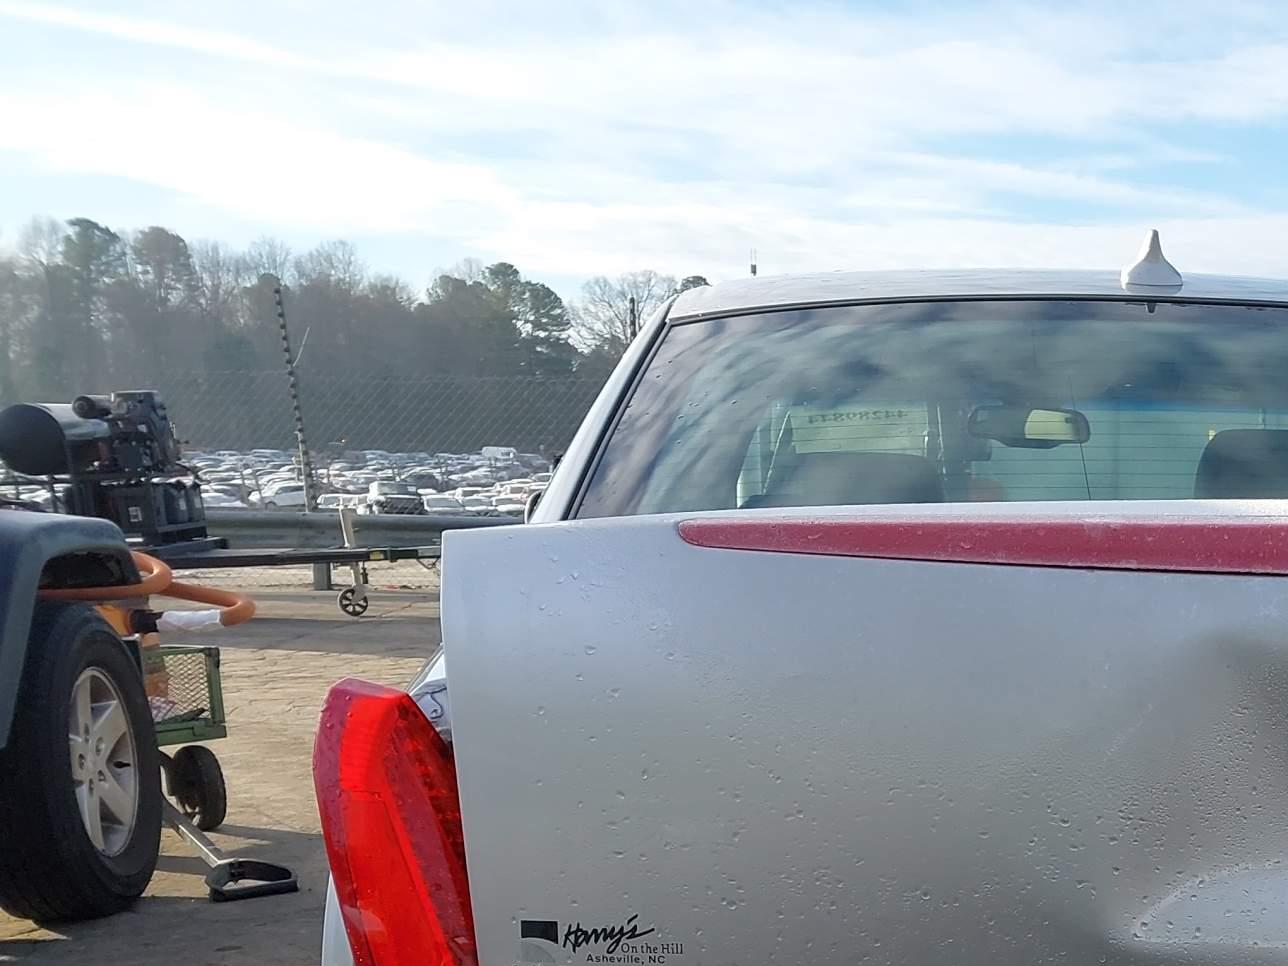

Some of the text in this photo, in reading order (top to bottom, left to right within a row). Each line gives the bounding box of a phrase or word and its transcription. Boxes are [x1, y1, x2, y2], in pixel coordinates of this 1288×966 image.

[562, 913, 655, 955] Harry's
[620, 942, 684, 955] On the Hill
[586, 953, 666, 966] Asheville, NC
